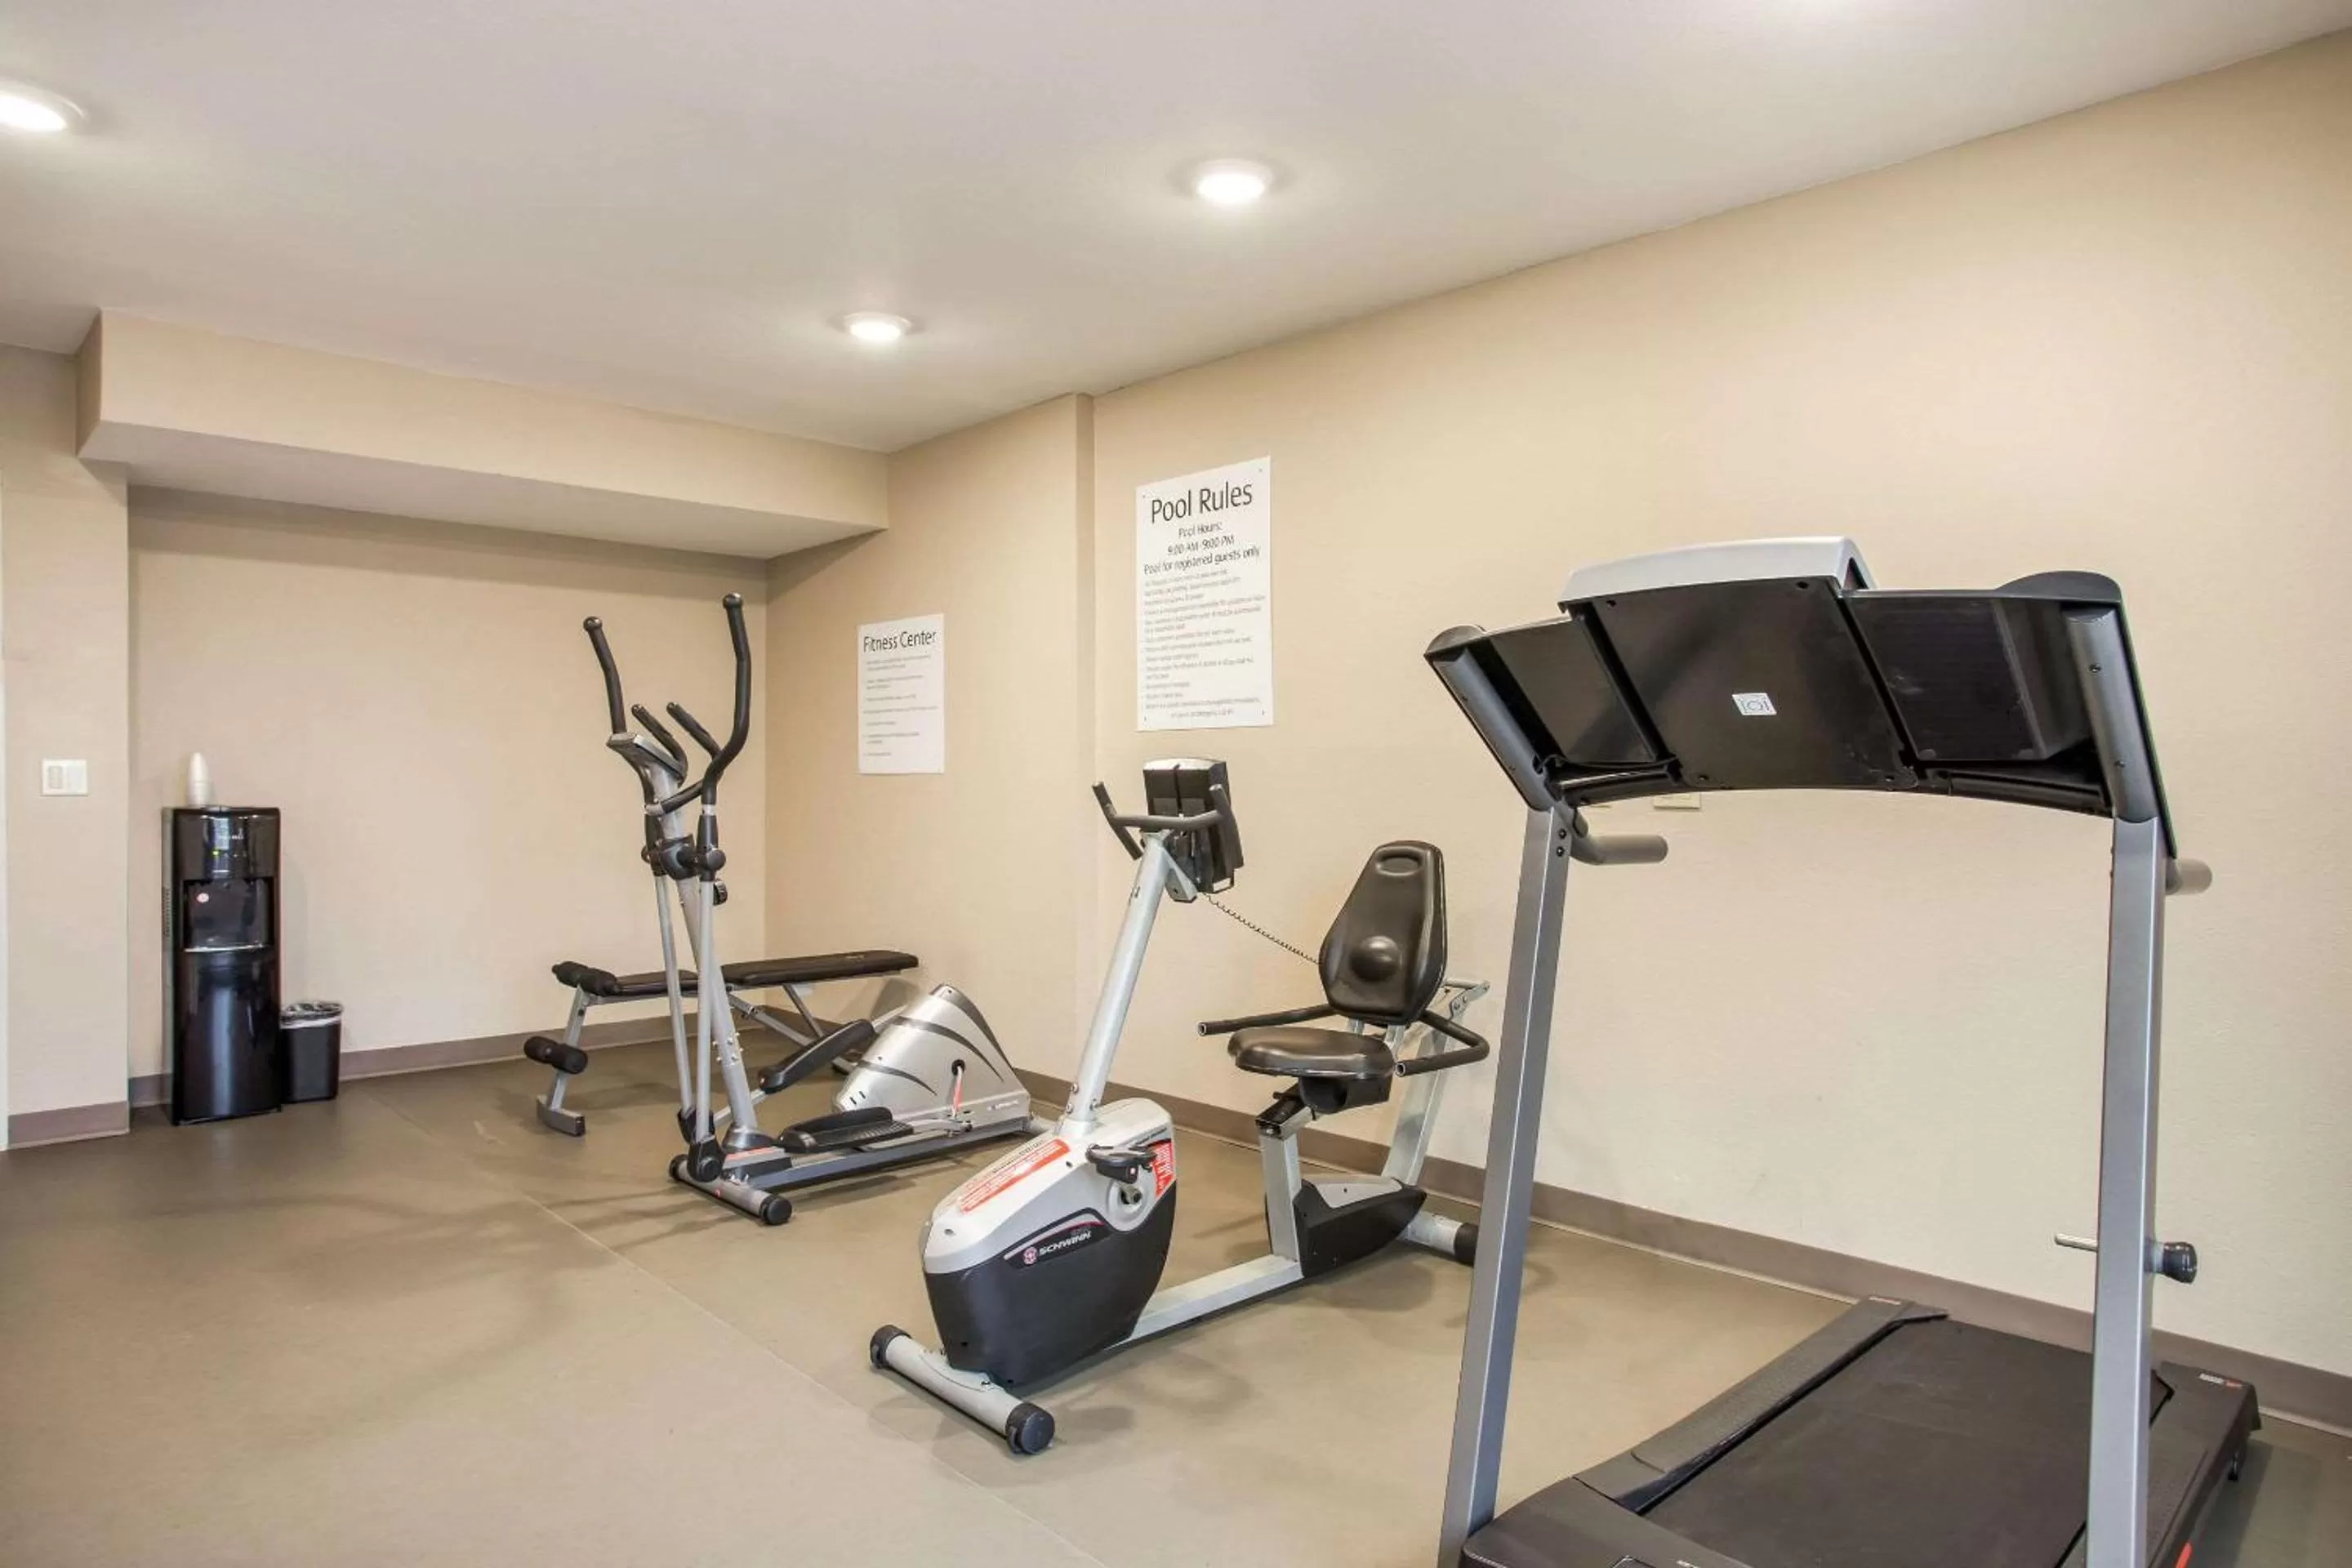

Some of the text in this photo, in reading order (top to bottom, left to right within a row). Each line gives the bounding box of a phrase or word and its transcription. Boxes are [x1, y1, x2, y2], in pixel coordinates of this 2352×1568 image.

[1152, 481, 1253, 523] Pool Rules
[1178, 527, 1196, 539] Pool
[1163, 561, 1173, 572] for
[1174, 553, 1212, 571] registered
[1214, 550, 1241, 565] guests
[1243, 545, 1260, 559] only
[863, 630, 937, 653] Fitness Center
[1039, 1231, 1092, 1256] SCHWINN
